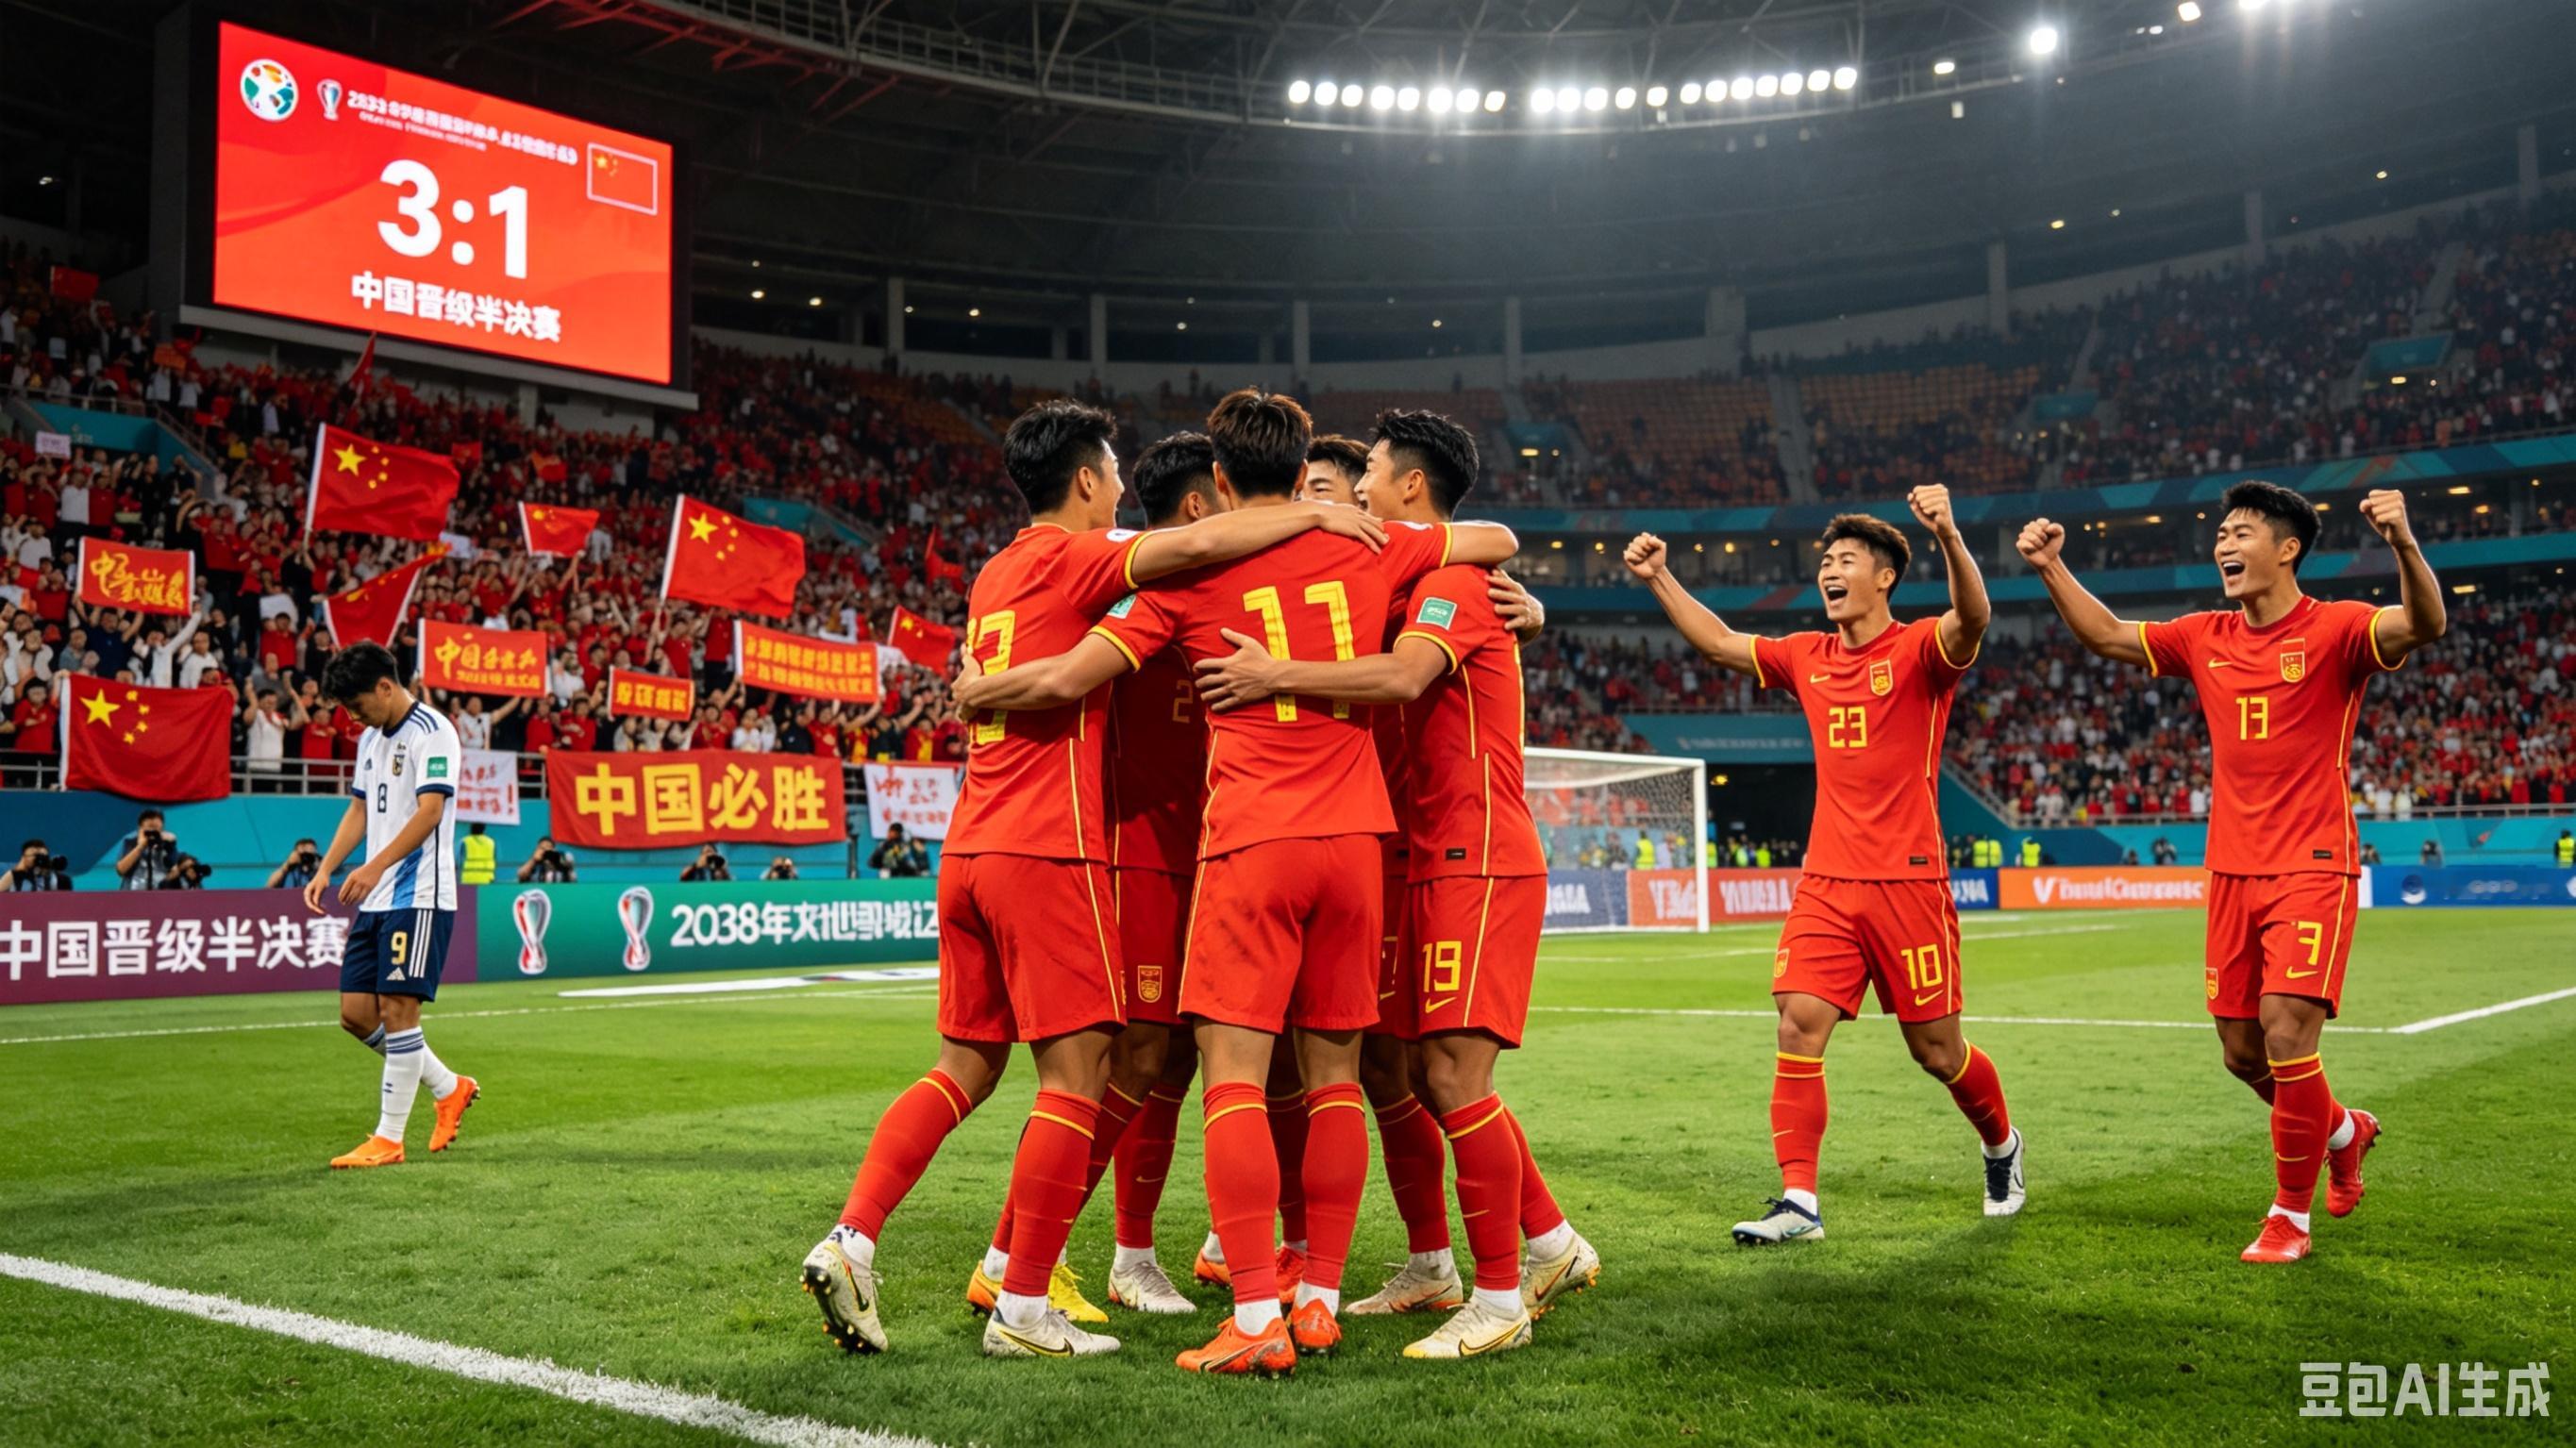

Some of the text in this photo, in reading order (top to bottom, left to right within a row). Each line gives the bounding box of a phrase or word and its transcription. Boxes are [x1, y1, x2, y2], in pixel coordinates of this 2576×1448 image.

[377, 158, 528, 279] 3:1
[351, 270, 562, 343] 中国晋级半决赛
[1243, 580, 1356, 723] 11
[1829, 706, 1867, 748] 23
[2235, 696, 2268, 741] 13
[575, 761, 830, 836] 中国必胜
[0, 914, 350, 982] 中国晋级半决赛
[391, 930, 408, 965] 9
[1422, 940, 1462, 992] 19
[1900, 943, 1944, 990] 10
